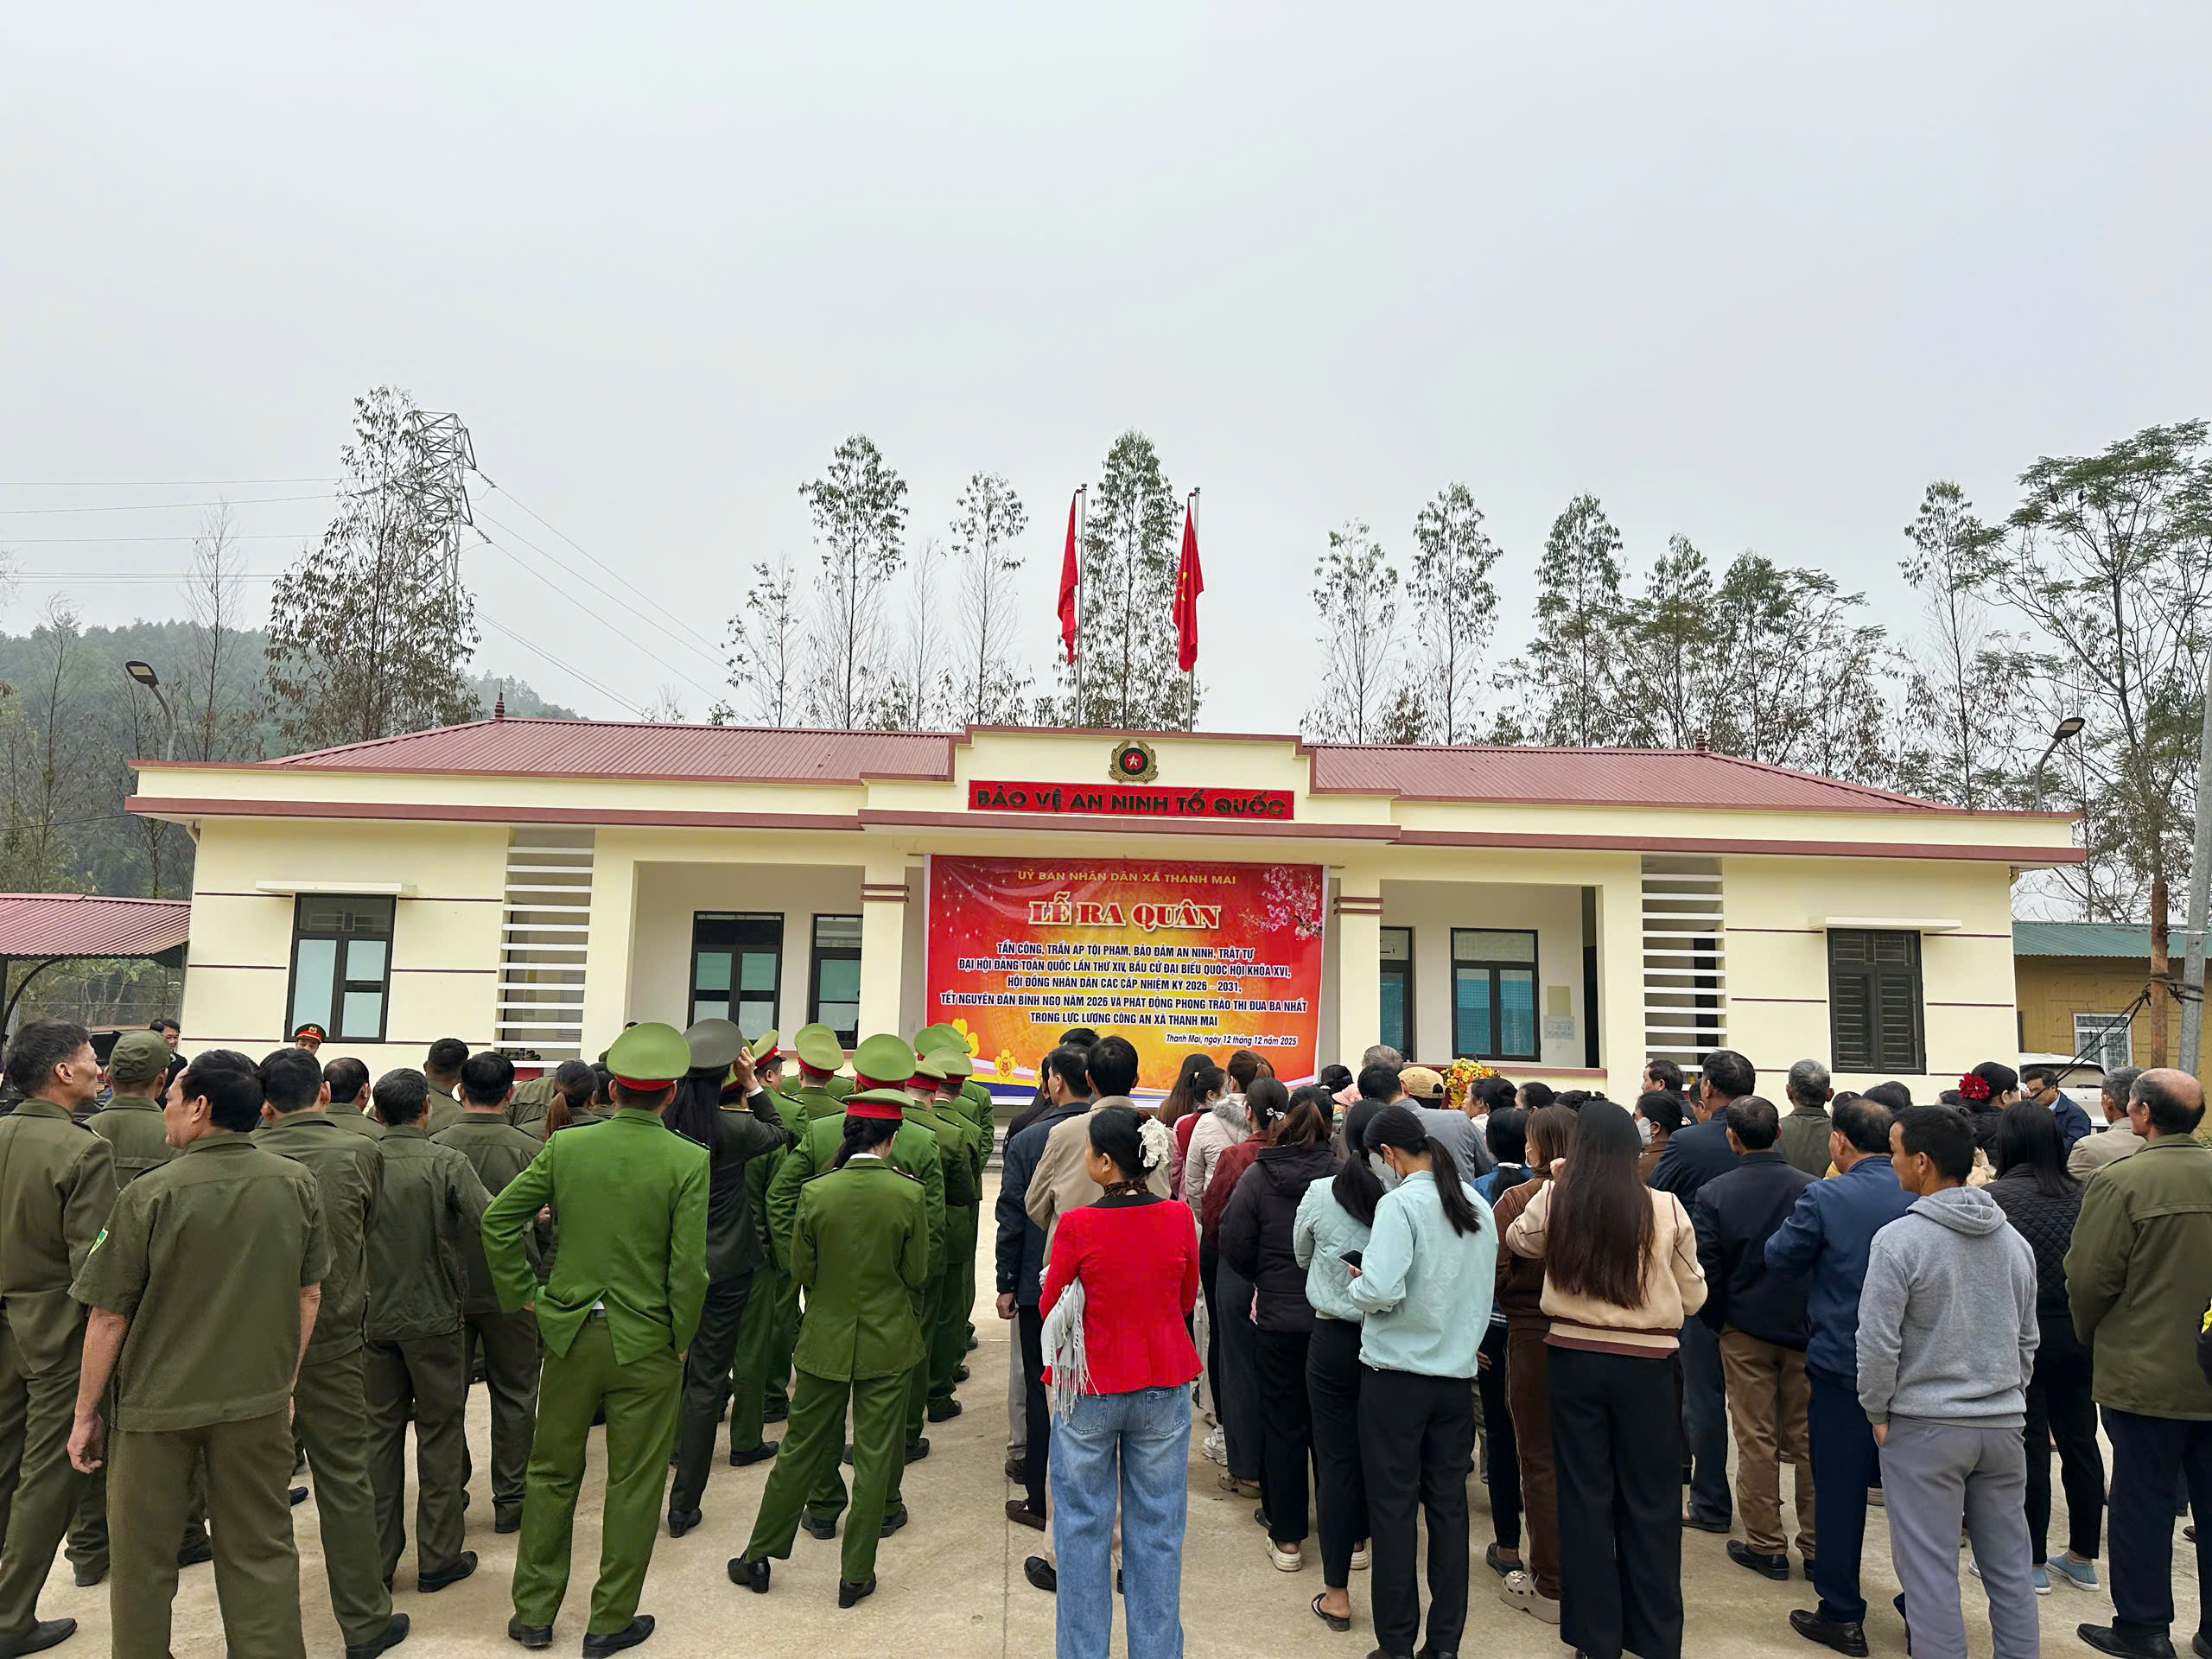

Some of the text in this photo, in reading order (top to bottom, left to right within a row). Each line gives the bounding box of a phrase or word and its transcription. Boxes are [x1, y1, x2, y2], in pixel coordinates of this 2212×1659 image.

[977, 785, 1286, 815] BẢO VỆ AN NINH TỔ QUỐC
[1039, 872, 1065, 880] BAN
[1069, 870, 1107, 880] NHÂN
[1110, 871, 1137, 881] DÂN
[1141, 872, 1160, 882] XÃ
[1165, 874, 1207, 884] THANH
[1211, 875, 1236, 885] MAI
[1028, 891, 1222, 932] LỄ RA QUÂN
[997, 940, 1255, 961] TẤN CÔNG, TRẤN ÁP TỘI PHẠM, BẢO ĐẢM AN NINH, TRẬT TỰ
[958, 959, 974, 971] ĐẠI
[976, 957, 992, 972] HỘI
[994, 957, 1019, 970] ĐẢNG
[1021, 958, 1044, 970] TOÀN
[1047, 957, 1071, 971] QUỐC
[1093, 960, 1110, 972] THỨ
[1149, 960, 1162, 973] CỬ
[1164, 963, 1179, 975] ĐẠI
[1181, 961, 1201, 974] BIỂU
[1204, 963, 1228, 975] QUỐC
[1230, 963, 1244, 977] HỘI
[1247, 963, 1271, 976] KHÓA
[1274, 966, 1291, 977] XVI,
[1007, 975, 1023, 988] HỘI
[1052, 976, 1077, 988] NHÂN
[1080, 976, 1098, 988] DÂN
[1101, 977, 1118, 988] CÁC
[1121, 976, 1138, 988] CẤP
[1141, 978, 1169, 991] NHIỆM
[1185, 981, 1207, 990] 2026
[1217, 982, 1242, 992] 2031,
[941, 990, 956, 1003] TẾT
[958, 993, 995, 1004] NGUYÊN
[997, 993, 1016, 1005] ĐÁN
[1042, 996, 1061, 1008] NGỌ
[1064, 995, 1084, 1006] NĂM
[1087, 997, 1108, 1007] 2026
[1110, 995, 1122, 1007] VÀ
[1123, 995, 1146, 1007] PHÁT
[1148, 996, 1173, 1009] ĐỘNG
[1175, 999, 1205, 1009] PHONG
[1208, 998, 1230, 1010] TRÀO
[1233, 1001, 1246, 1010] THI
[1249, 1001, 1267, 1011] ĐUA
[1269, 1001, 1282, 1011] BA
[1284, 999, 1307, 1012] NHẤT
[1031, 1012, 1217, 1026] TRONG LỰC LƯỢNG CÔNG AN XÃ THANH MAI
[1166, 1034, 1188, 1043] Thanh
[1188, 1034, 1202, 1045] Mai,
[1204, 1036, 1222, 1046] ngày
[1232, 1035, 1252, 1046] tháng
[1280, 1037, 1297, 1046] 2025
